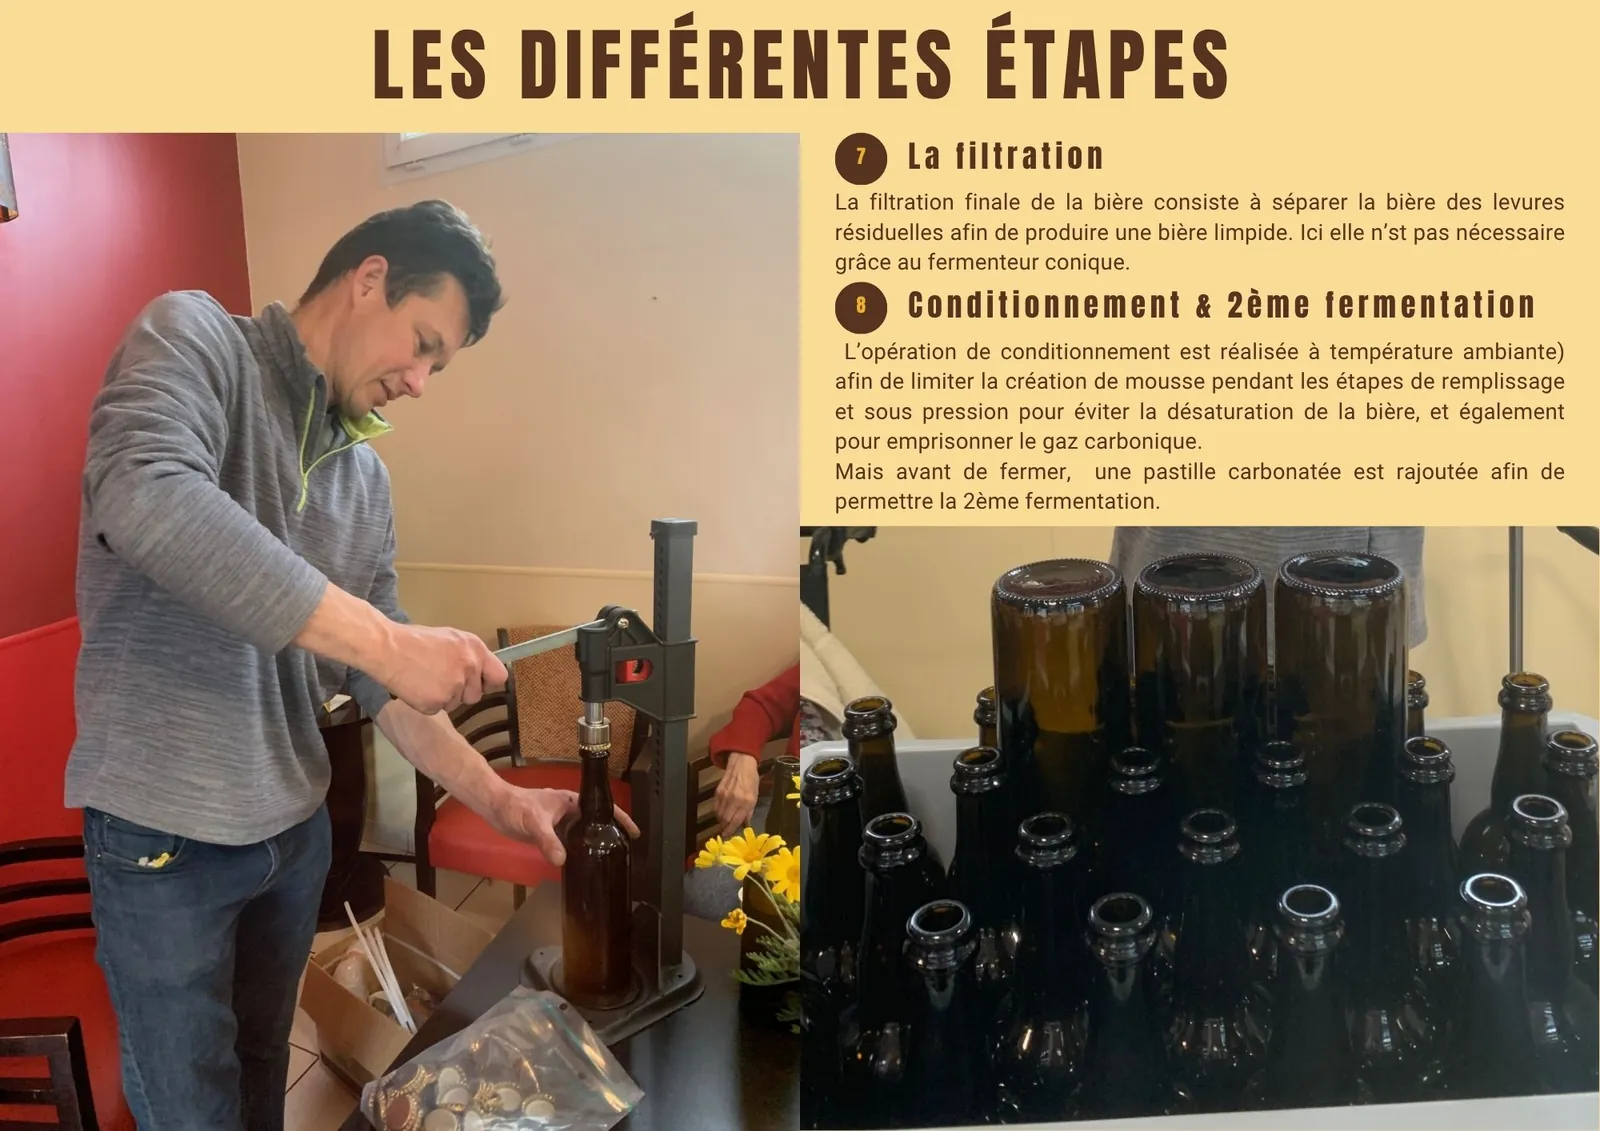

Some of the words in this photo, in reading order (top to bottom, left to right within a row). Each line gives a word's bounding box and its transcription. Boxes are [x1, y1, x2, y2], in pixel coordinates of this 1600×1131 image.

[373, 28, 486, 100] LES
[520, 10, 952, 100] DIFFÉRENTES
[986, 10, 1228, 100] ÉTAPES
[856, 147, 866, 165] 7
[908, 141, 940, 170] La
[955, 140, 1103, 170] filtration
[835, 192, 859, 211] La
[869, 192, 954, 211] filtration
[964, 191, 1021, 211] finale
[1030, 192, 1056, 211] de
[1066, 192, 1083, 211] la
[1094, 192, 1144, 211] bière
[1153, 192, 1240, 211] consiste
[1249, 192, 1261, 211] à
[1272, 192, 1349, 216] séparer
[1358, 192, 1376, 211] la
[1386, 192, 1436, 211] bière
[1446, 192, 1482, 211] des
[1493, 192, 1565, 211] levures
[835, 222, 944, 241] résiduelles
[950, 222, 988, 241] afin
[994, 222, 1019, 241] de
[1025, 222, 1109, 246] produire
[1115, 227, 1152, 241] une
[1158, 222, 1208, 241] bière
[1214, 222, 1293, 246] limpide.
[1301, 223, 1323, 241] Ici
[1329, 222, 1365, 241] elle
[1371, 222, 1407, 241] n’st
[1413, 227, 1450, 246] pas
[1456, 222, 1565, 241] nécessaire
[835, 252, 892, 276] grâce
[897, 256, 921, 271] au
[927, 251, 1040, 271] fermenteur
[1044, 252, 1130, 276] conique.
[856, 295, 867, 314] 8
[908, 289, 1180, 319] Conditionnement
[1195, 293, 1212, 319] &
[1227, 287, 1310, 319] 2ème
[1325, 289, 1534, 319] fermentation
[845, 341, 957, 365] L’opération
[966, 341, 991, 361] de
[1000, 341, 1171, 361] conditionnement
[1179, 343, 1211, 361] est
[1220, 341, 1299, 361] réalisée
[1308, 341, 1320, 361] à
[1329, 341, 1454, 365] température
[1463, 340, 1565, 365] ambiante)
[835, 371, 873, 390] afin
[879, 371, 905, 390] de
[911, 371, 975, 390] limiter
[981, 371, 998, 390] la
[1005, 371, 1087, 390] création
[1094, 371, 1119, 390] de
[1125, 375, 1206, 390] mousse
[1212, 371, 1294, 395] pendant
[1300, 371, 1329, 390] les
[1336, 371, 1404, 395] étapes
[1410, 371, 1435, 390] de
[1442, 371, 1565, 395] remplissage
[835, 403, 855, 421] et
[864, 406, 913, 421] sous
[922, 402, 1009, 425] pression
[1019, 406, 1065, 425] pour
[1074, 401, 1131, 421] éviter
[1140, 401, 1157, 421] la
[1167, 401, 1294, 421] désaturation
[1304, 401, 1329, 421] de
[1338, 401, 1356, 421] la
[1366, 401, 1420, 423] bière,
[1429, 403, 1450, 421] et
[1459, 401, 1565, 425] également
[835, 435, 881, 455] pour
[886, 432, 1014, 455] emprisonner
[1019, 431, 1037, 450] le
[1042, 435, 1079, 455] gaz
[1084, 431, 1202, 455] carbonique.
[835, 462, 884, 481] Mais
[896, 463, 952, 481] avant
[963, 461, 988, 481] de
[999, 461, 1071, 483] fermer,
[1095, 466, 1132, 481] une
[1143, 461, 1216, 485] pastille
[1228, 461, 1342, 481] carbonatée
[1353, 463, 1385, 481] est
[1396, 461, 1479, 485] rajoutée
[1490, 461, 1528, 481] afin
[1540, 461, 1565, 481] de
[835, 493, 934, 515] permettre
[940, 491, 957, 510] la
[963, 491, 1020, 510] 2ème
[1024, 491, 1160, 510] fermentation.
